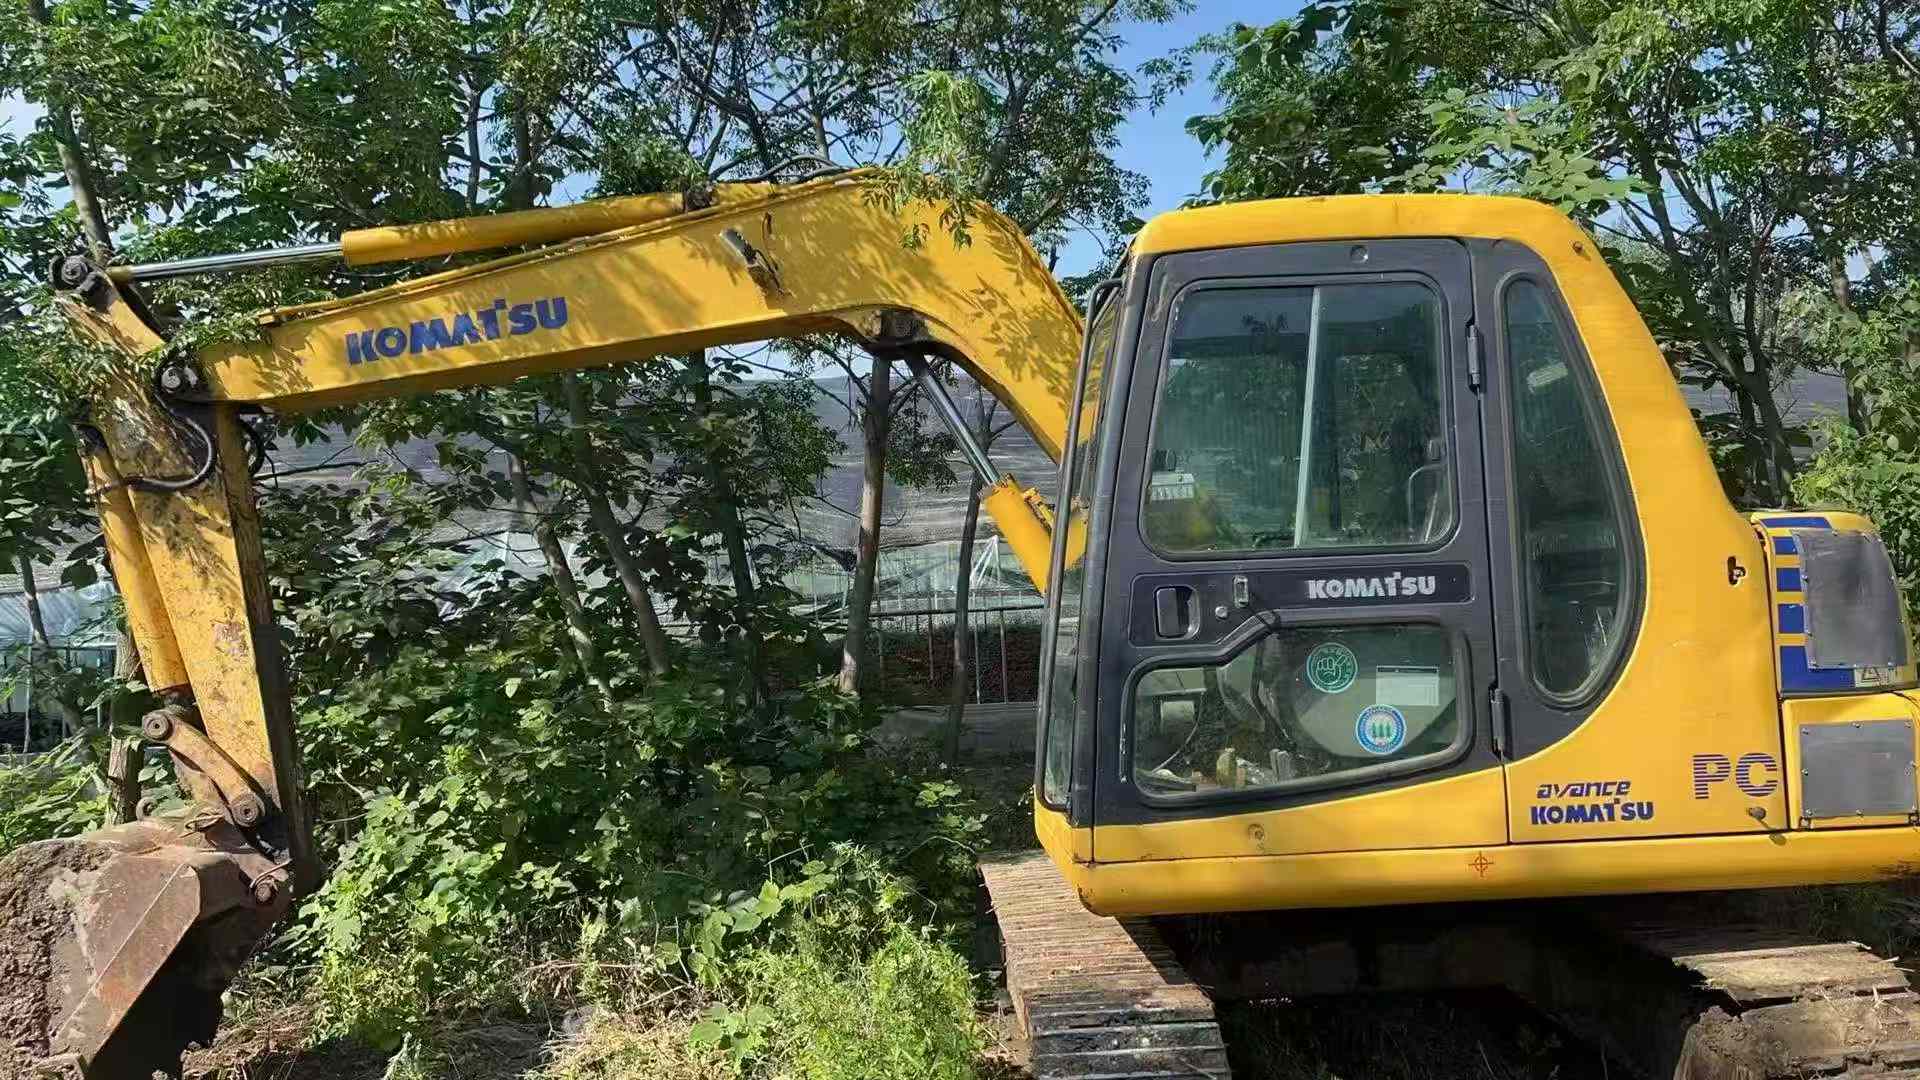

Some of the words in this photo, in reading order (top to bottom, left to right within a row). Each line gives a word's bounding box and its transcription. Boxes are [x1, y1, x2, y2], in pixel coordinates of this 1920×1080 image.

[345, 297, 568, 365] KOMATSU
[1308, 571, 1436, 599] KOMATSU
[1536, 780, 1631, 798] avance
[1692, 752, 1778, 800] PC
[1530, 798, 1654, 825] KOMATSU
